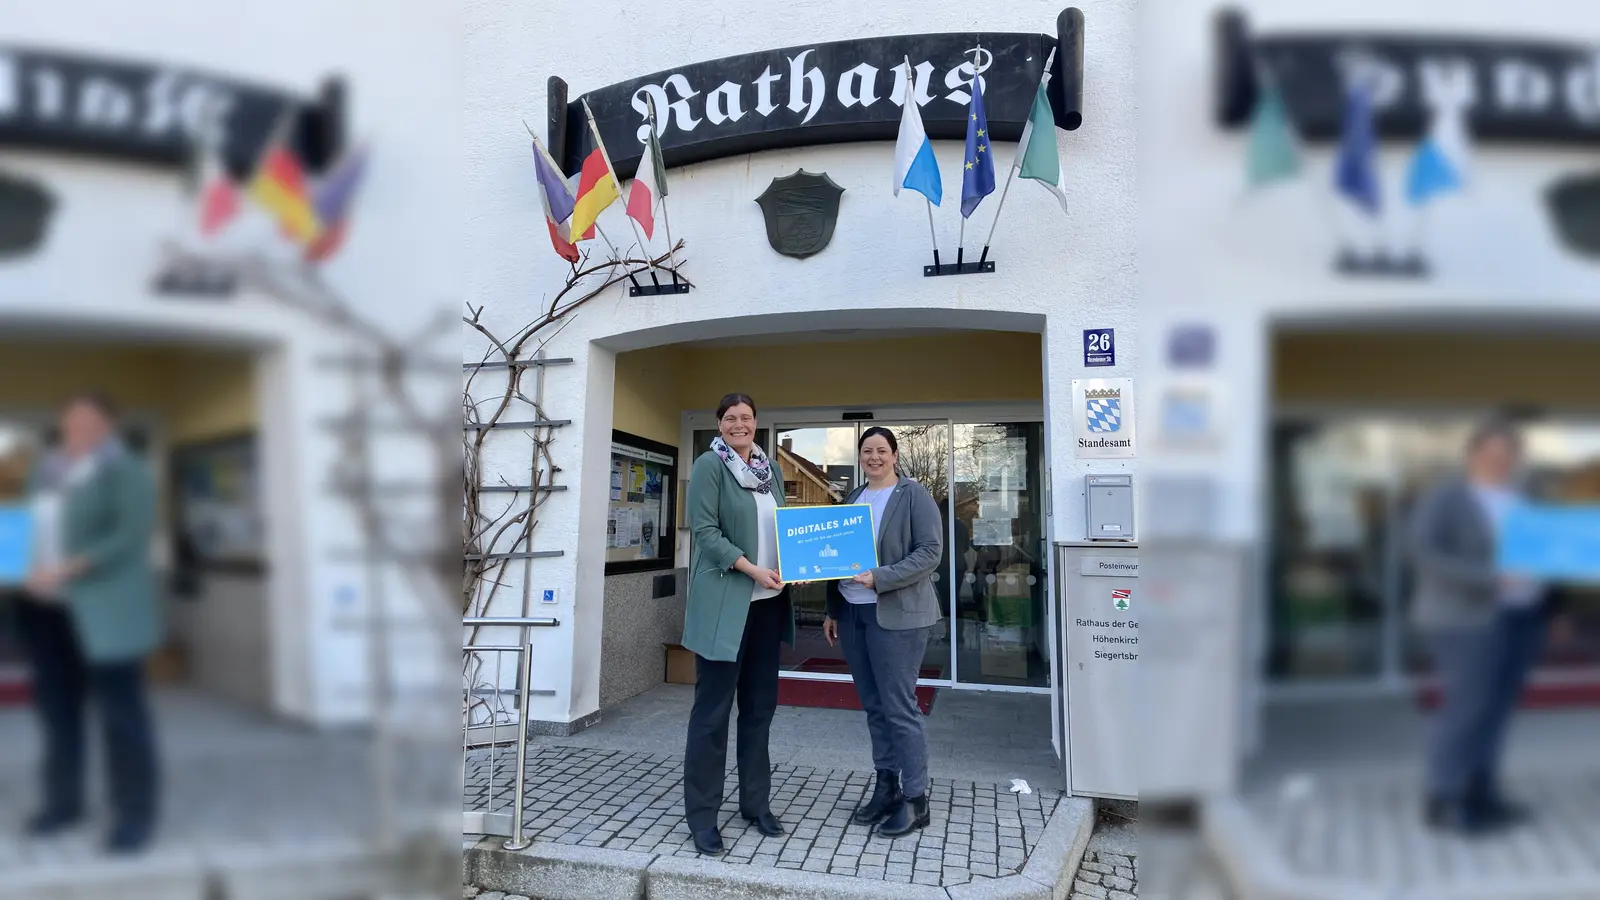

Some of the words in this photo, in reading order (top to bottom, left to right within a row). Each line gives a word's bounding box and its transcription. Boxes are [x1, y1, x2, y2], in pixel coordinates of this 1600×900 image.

[631, 48, 993, 145] Rathaus
[1088, 333, 1111, 351] 26
[1078, 437, 1131, 448] Standesamt
[787, 520, 839, 537] DIGITALES
[843, 516, 863, 527] AMT
[1076, 618, 1109, 628] Rathaus
[1112, 619, 1126, 628] der
[1094, 650, 1138, 661] Siegertsbr
